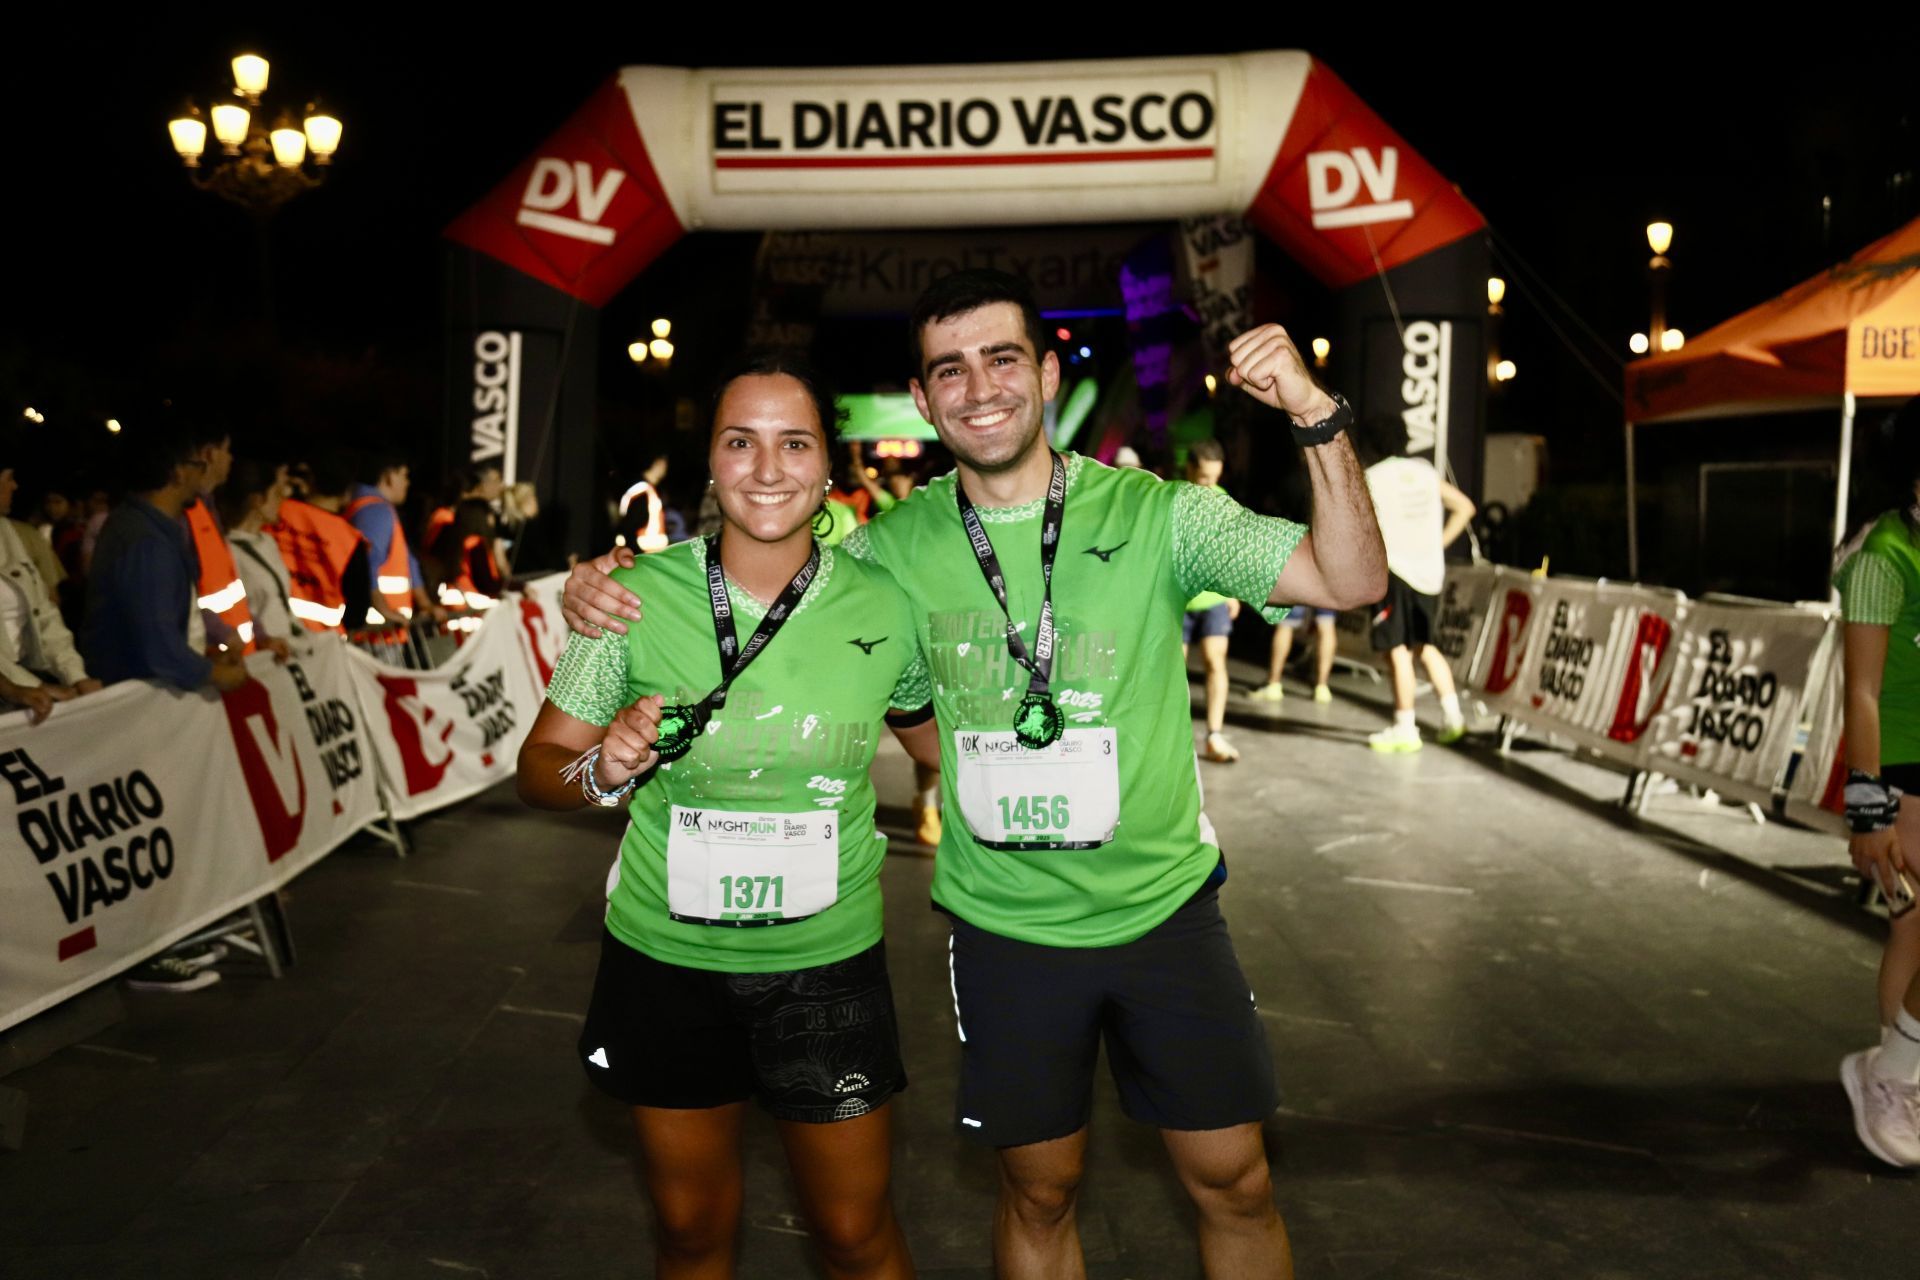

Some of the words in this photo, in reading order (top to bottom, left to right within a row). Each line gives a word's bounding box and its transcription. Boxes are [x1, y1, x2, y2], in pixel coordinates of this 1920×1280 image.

[715, 102, 781, 149] EL
[793, 99, 1000, 149] DIARIO
[1011, 92, 1214, 146] VASCO
[523, 158, 626, 223] DV
[1306, 146, 1398, 210] DV
[1861, 326, 1920, 360] DGE
[471, 331, 508, 463] VASCO
[1401, 320, 1440, 454] VASCO
[962, 507, 992, 558] FINISHER
[708, 564, 731, 618] FINISHER
[1709, 630, 1732, 664] EL
[1058, 689, 1103, 709] 2025
[962, 736, 980, 754] 10K
[1102, 740, 1111, 755] 3
[0, 748, 65, 805] EL
[806, 775, 848, 794] 2025
[18, 769, 163, 864] DIARIO
[679, 811, 703, 831] 10K
[824, 824, 833, 839] 3
[997, 795, 1070, 830] 1456
[784, 829, 807, 837] VASCO
[46, 826, 174, 924] VASCO
[719, 876, 784, 908] 1371
[842, 1083, 863, 1093] WASTE
[845, 1072, 870, 1086] PLASTIC
